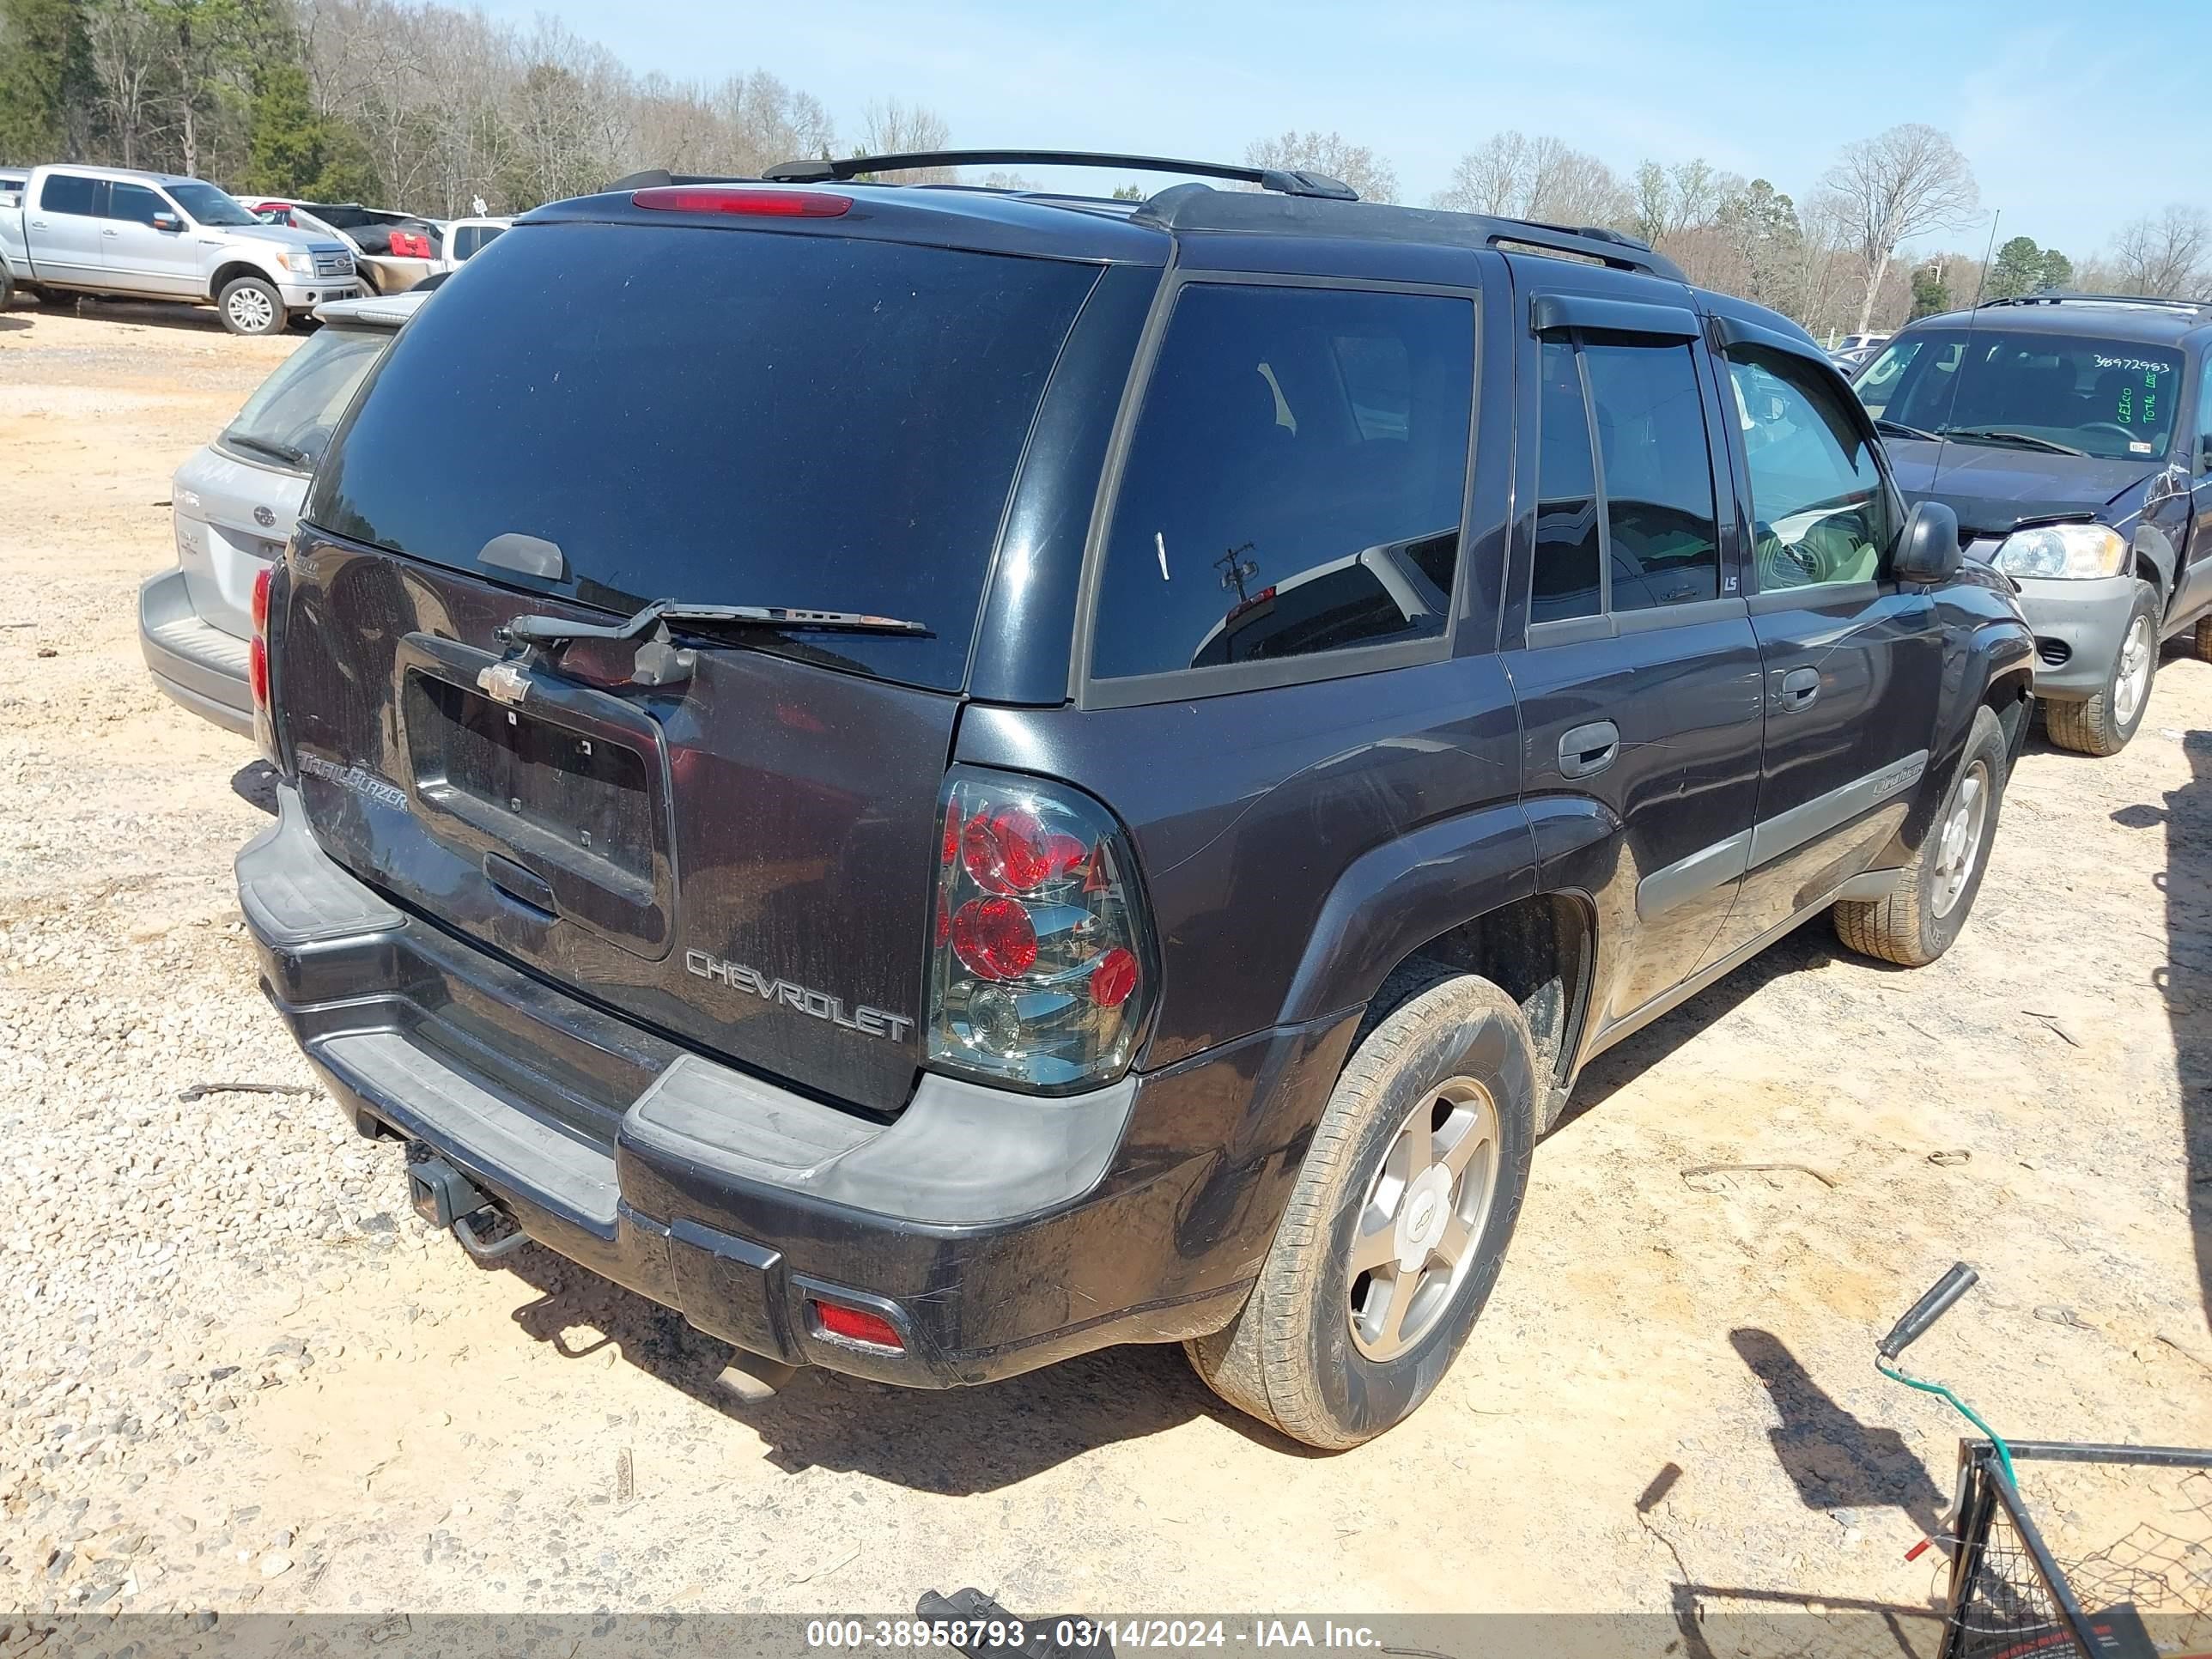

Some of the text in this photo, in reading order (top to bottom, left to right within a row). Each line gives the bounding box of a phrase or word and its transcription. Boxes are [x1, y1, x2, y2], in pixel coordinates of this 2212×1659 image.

[2093, 354, 2171, 374] 38972983
[2117, 387, 2132, 423] GEICO
[2142, 394, 2156, 423] TOTAL
[1723, 576, 1738, 592] LS
[296, 749, 410, 815] TRAILBLAZER
[685, 948, 915, 1042] CHEVROLET
